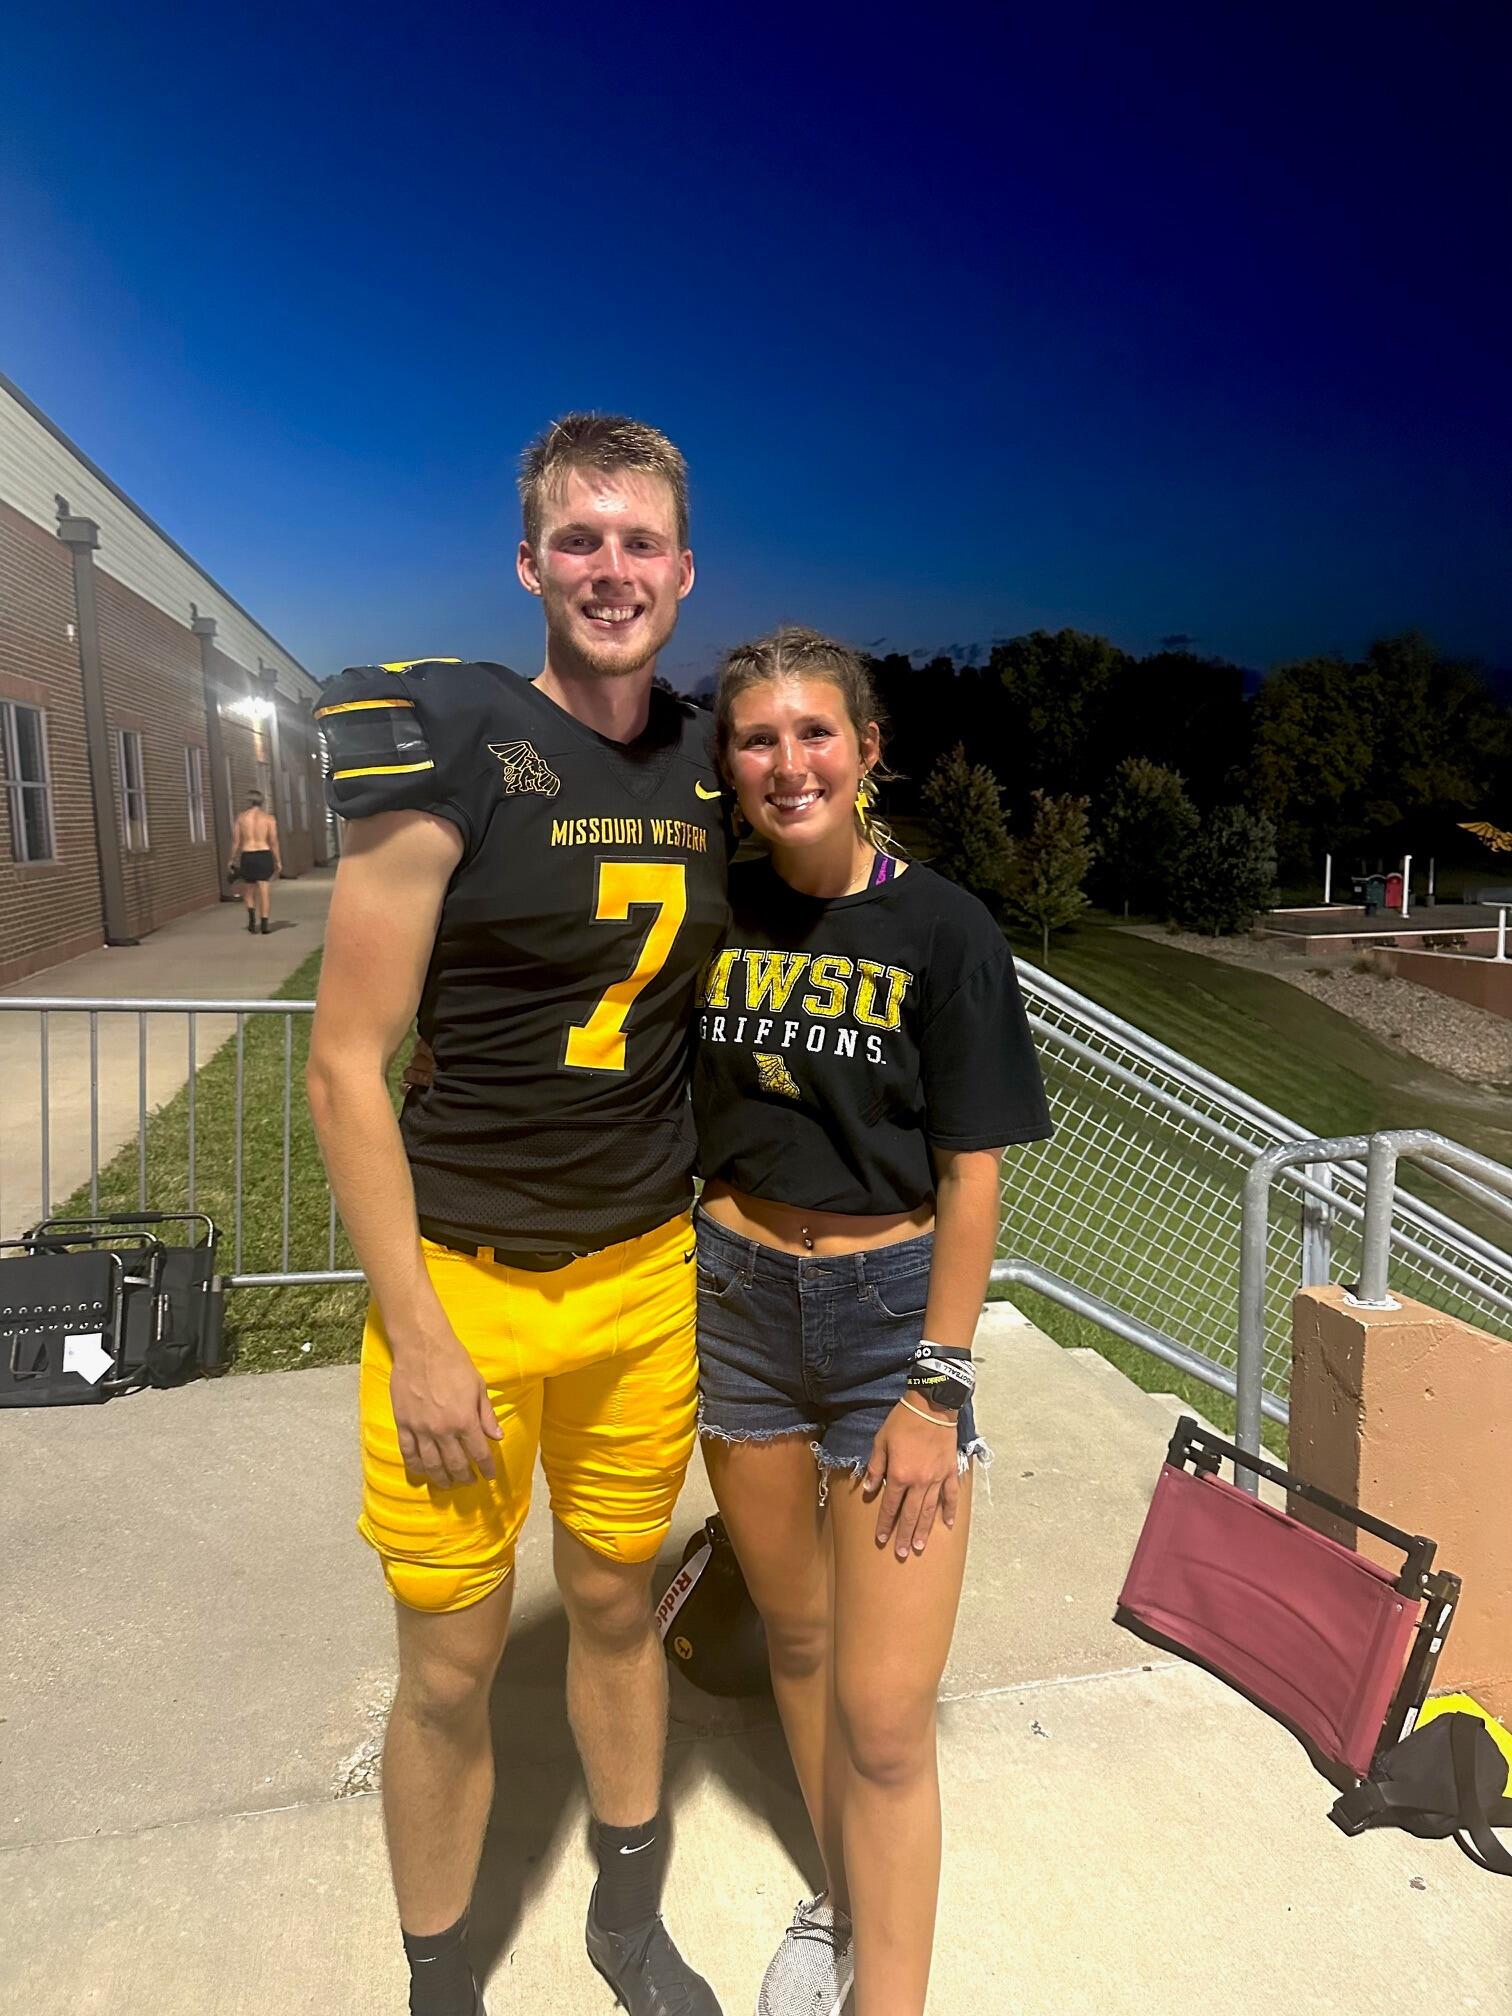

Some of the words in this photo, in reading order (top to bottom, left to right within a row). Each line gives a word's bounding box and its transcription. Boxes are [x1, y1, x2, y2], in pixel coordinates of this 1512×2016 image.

[551, 817, 642, 847] MISSOURI
[650, 818, 707, 852] WESTERN
[563, 861, 688, 1071] 7
[695, 949, 913, 1031] MWSU
